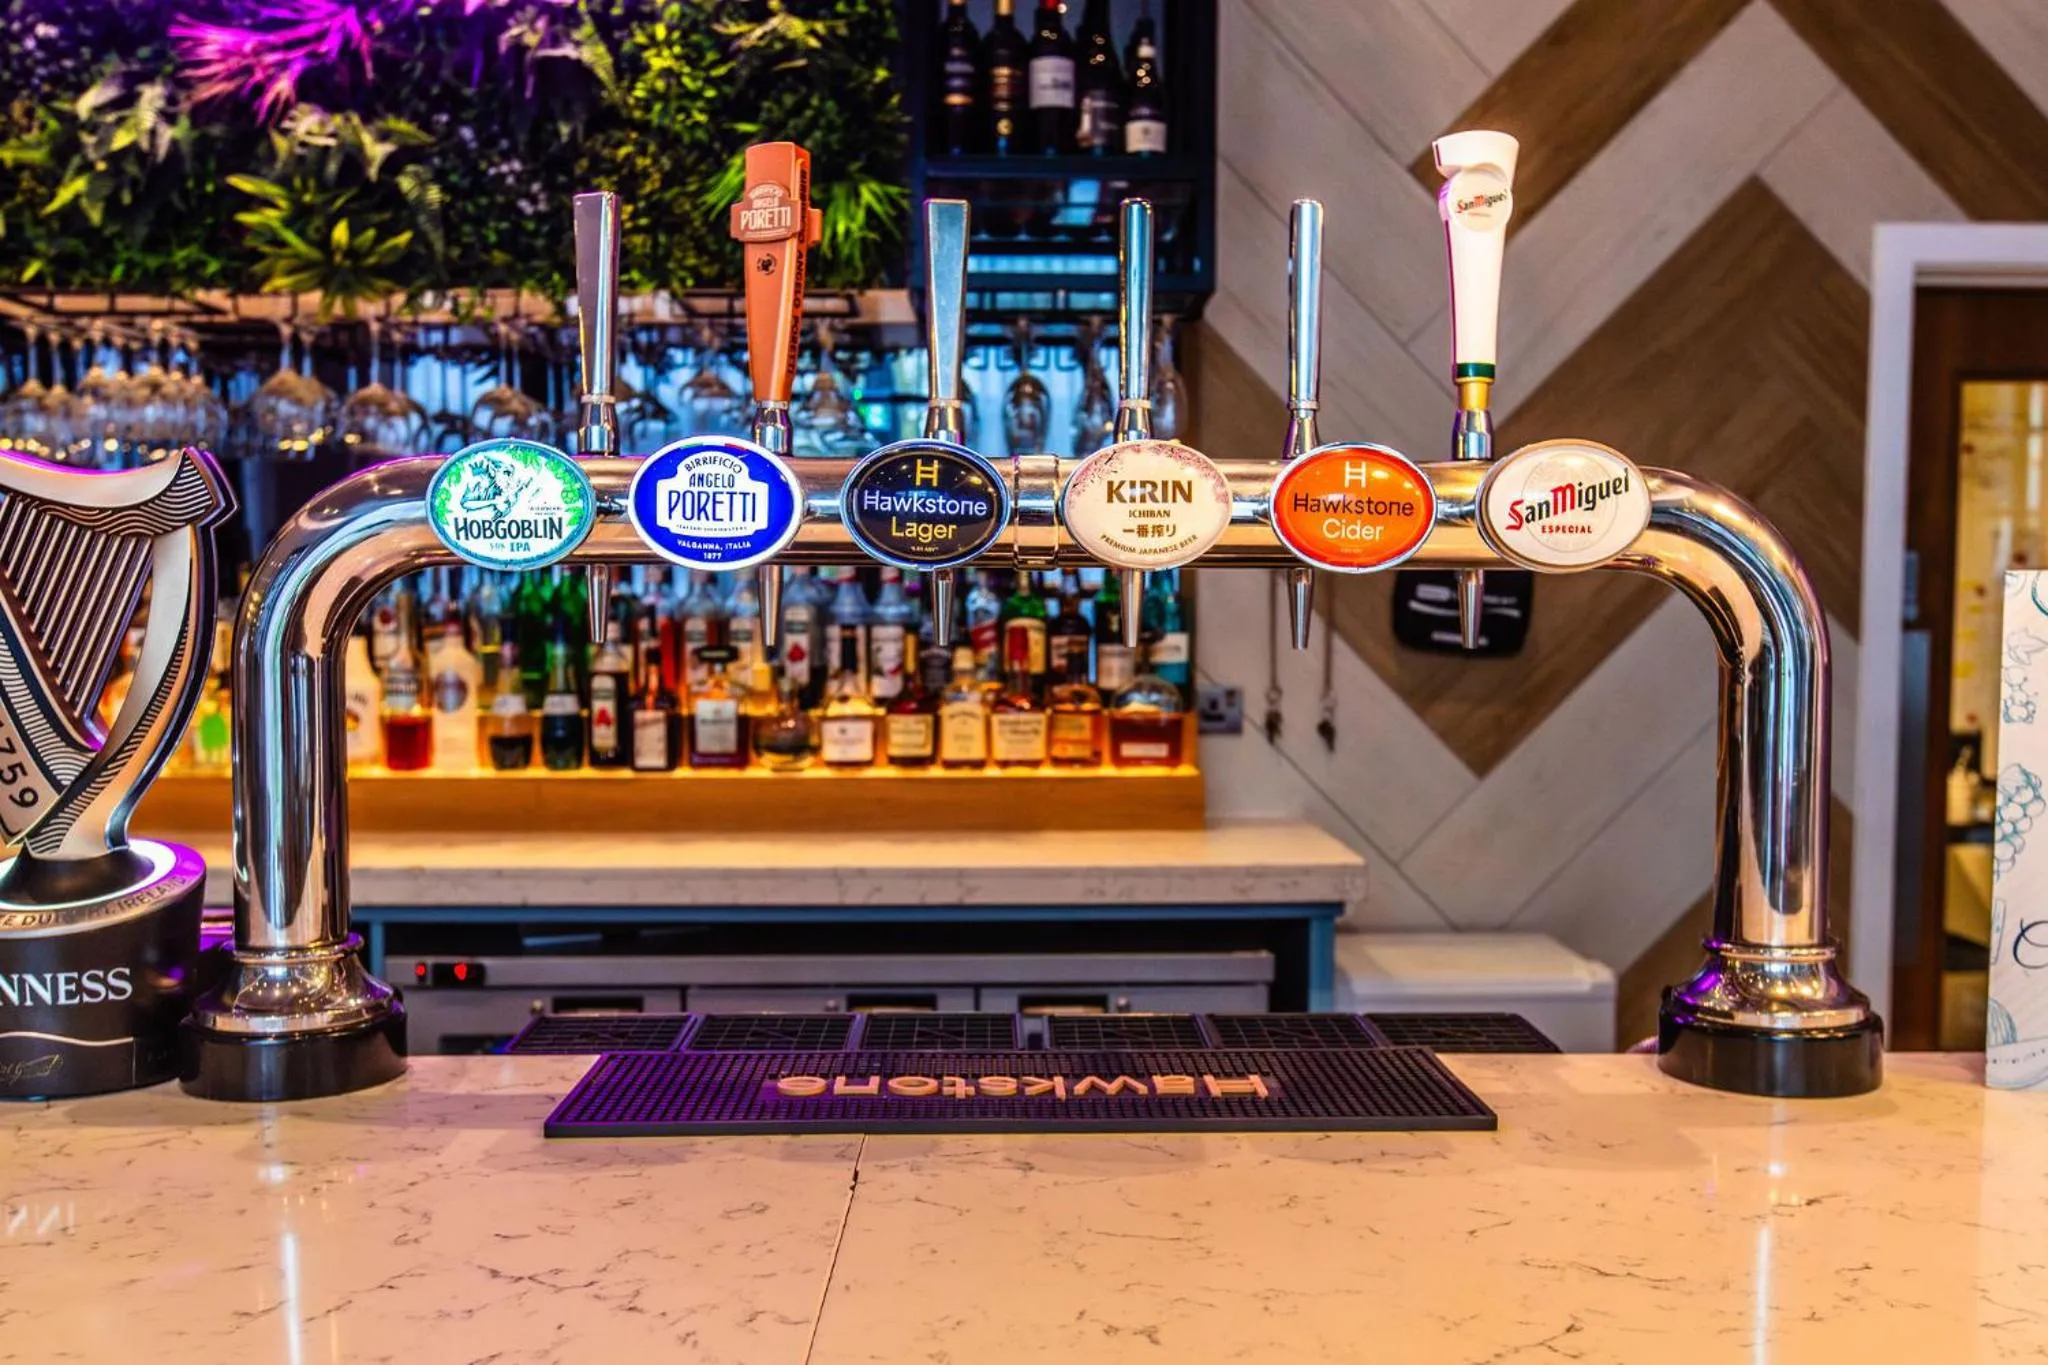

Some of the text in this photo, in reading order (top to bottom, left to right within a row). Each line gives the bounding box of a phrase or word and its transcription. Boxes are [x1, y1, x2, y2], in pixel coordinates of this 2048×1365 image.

[740, 206, 792, 231] PORETTI
[684, 455, 743, 474] BIRRIFICIO
[689, 473, 736, 488] ANGELO
[863, 489, 988, 516] Hawkstone
[1106, 480, 1193, 504] KIRIN
[668, 490, 756, 522] PORETTI
[1129, 509, 1171, 518] ICHIBAN
[1293, 493, 1414, 516] Hawkstone
[454, 517, 563, 540] HOBGOBLIN
[891, 516, 957, 543] Lager
[1122, 523, 1177, 538] 一番搾り
[1322, 518, 1385, 541] Cider
[1541, 525, 1593, 534] ESPECIAL
[509, 542, 531, 552] IPA
[725, 541, 752, 550] ITALIA
[1100, 534, 1198, 555] PREMIUM JAPANESE BEER
[703, 552, 722, 560] 1877
[777, 1074, 1268, 1101] Hawkstone
